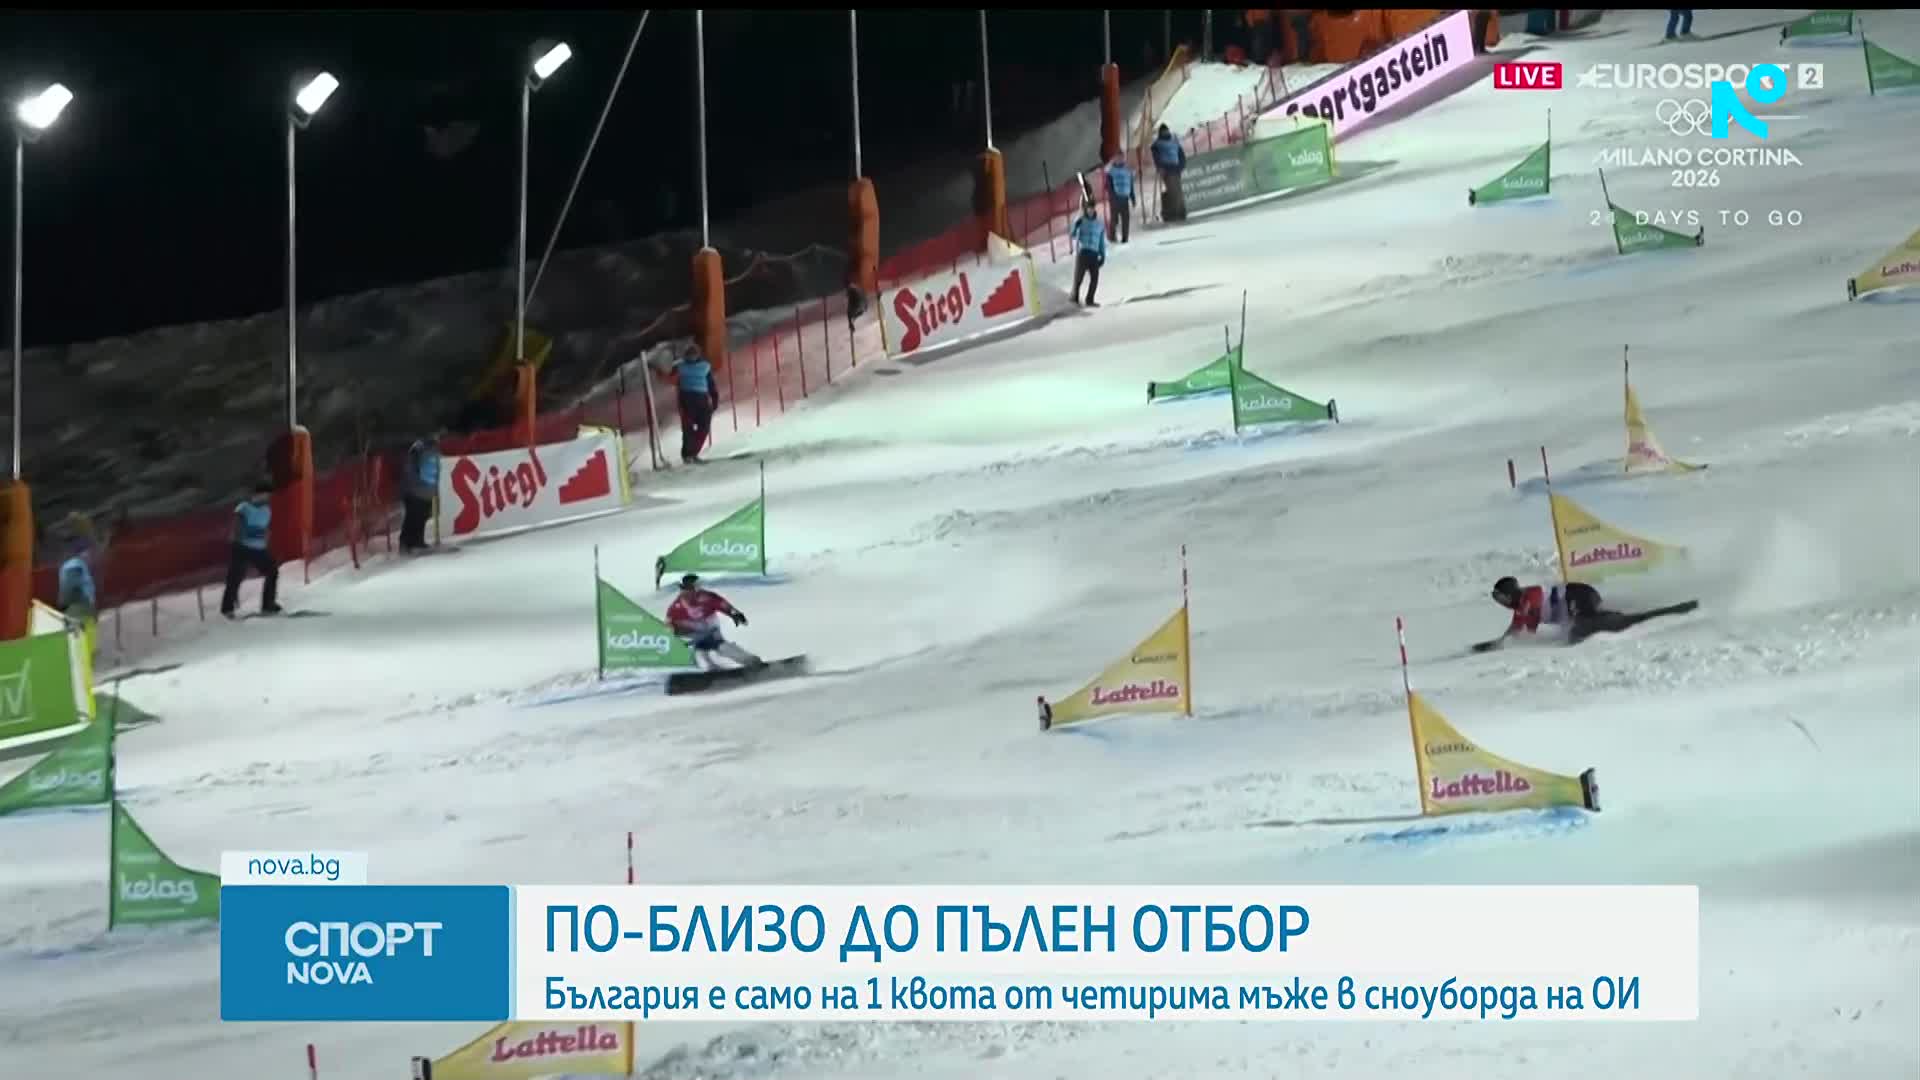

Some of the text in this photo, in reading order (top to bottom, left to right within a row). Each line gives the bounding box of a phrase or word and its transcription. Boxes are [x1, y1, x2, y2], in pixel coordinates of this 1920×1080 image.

[893, 271, 972, 353] Stiegl
[451, 447, 547, 535] Stiegl
[1091, 679, 1180, 705] Lattella
[1431, 769, 1531, 799] Lattella
[492, 1023, 618, 1062] Lattella
